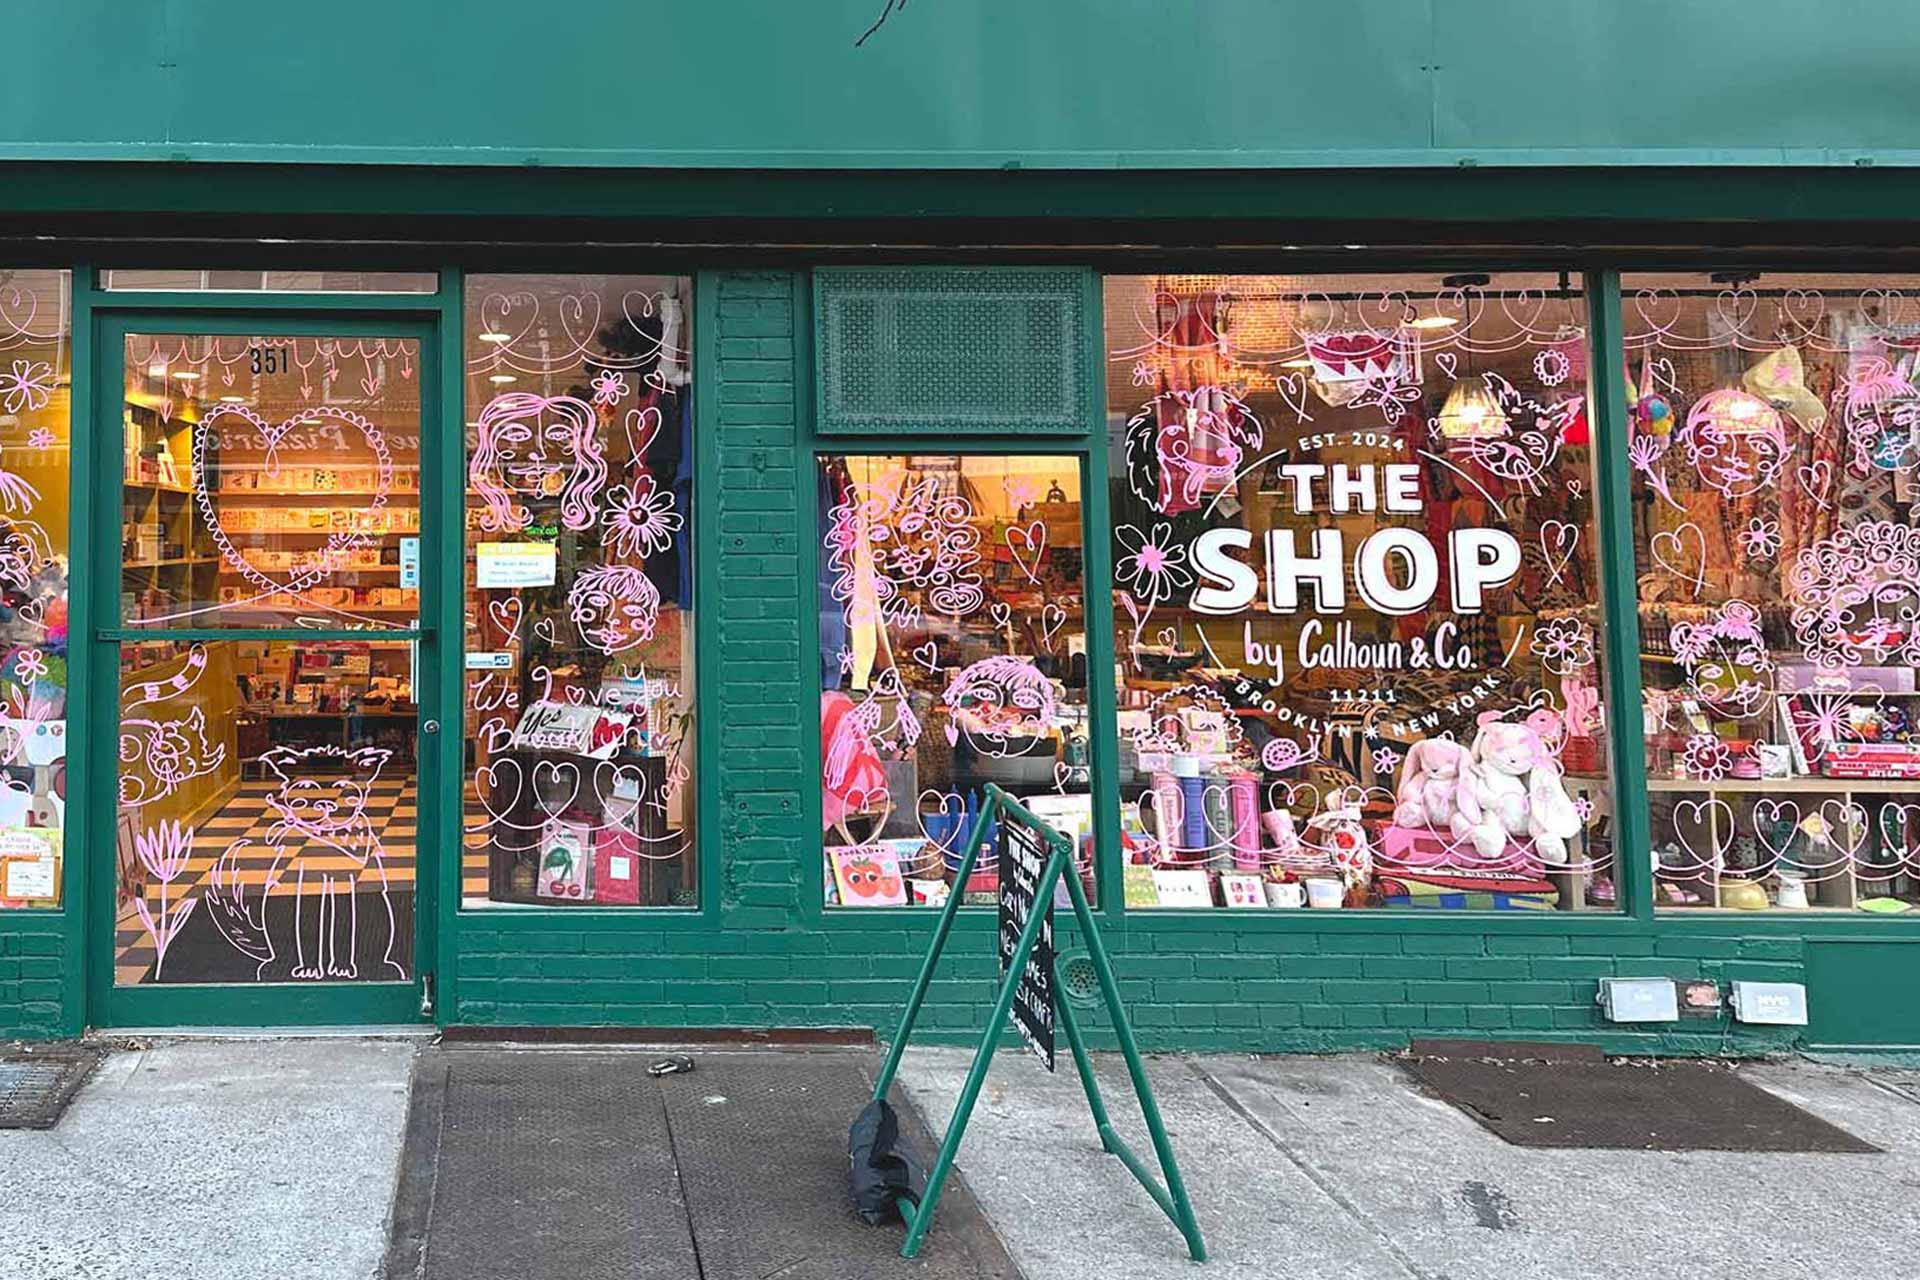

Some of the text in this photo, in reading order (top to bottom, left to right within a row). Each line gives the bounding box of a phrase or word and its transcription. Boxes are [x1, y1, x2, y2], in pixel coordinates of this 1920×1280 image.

[250, 348, 288, 374] 351
[1298, 432, 1404, 451] EST. 2024
[1279, 463, 1424, 516] THE
[1188, 526, 1523, 615] SHOP
[1244, 620, 1285, 687] by
[1299, 618, 1403, 669] Calhoun
[469, 672, 520, 711] We
[1234, 673, 1500, 739] BROOKLYN NEW YORK
[1329, 688, 1397, 703] 11211
